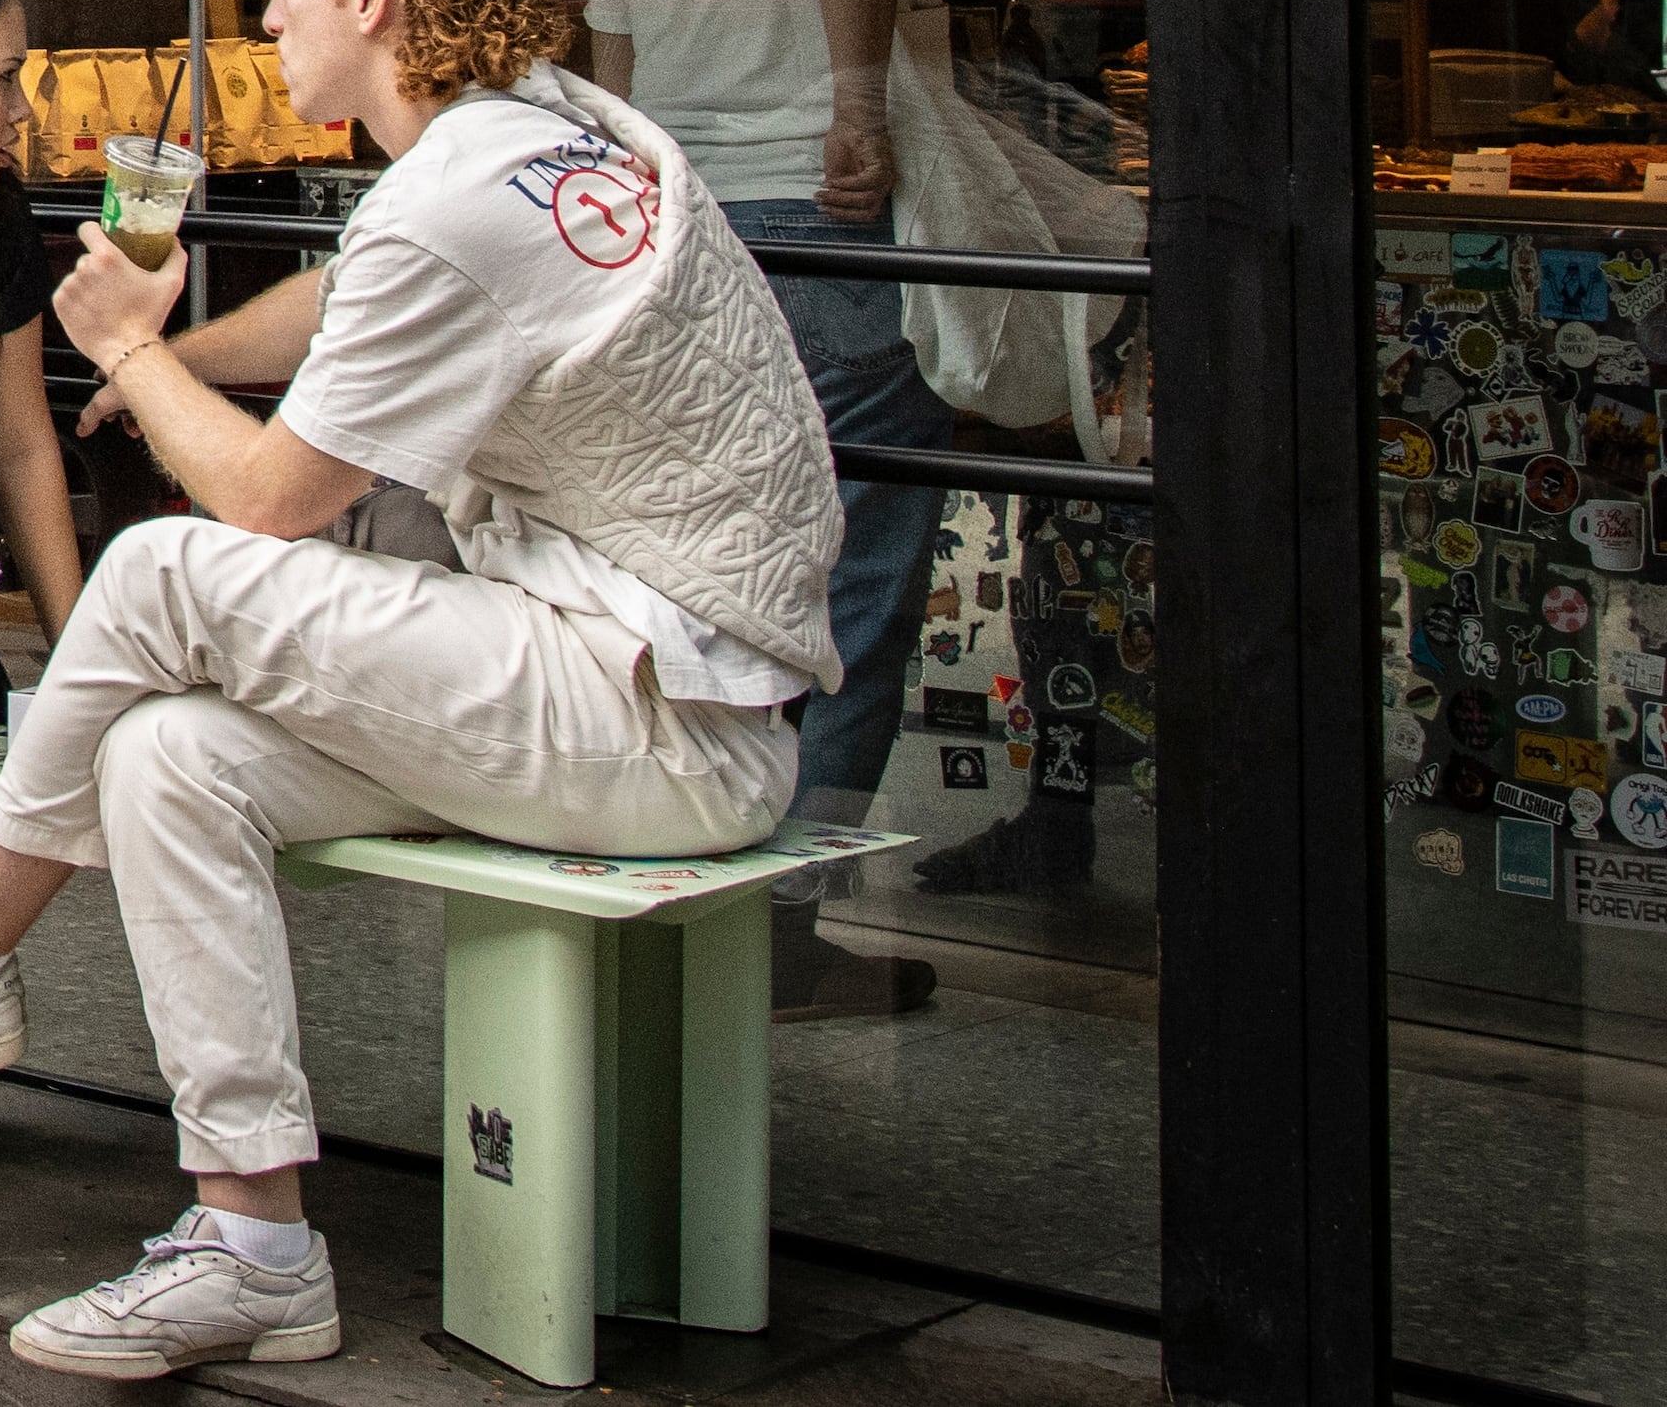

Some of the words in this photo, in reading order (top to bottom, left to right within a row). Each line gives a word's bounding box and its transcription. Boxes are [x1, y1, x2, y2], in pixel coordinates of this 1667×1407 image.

[1381, 247, 1388, 261] I
[1617, 272, 1667, 315] SEGUND
[1630, 288, 1664, 319] GOLF
[1496, 782, 1563, 823] MILKSHAKE
[1575, 856, 1667, 885] RARE
[1577, 892, 1667, 923] FOREVER
